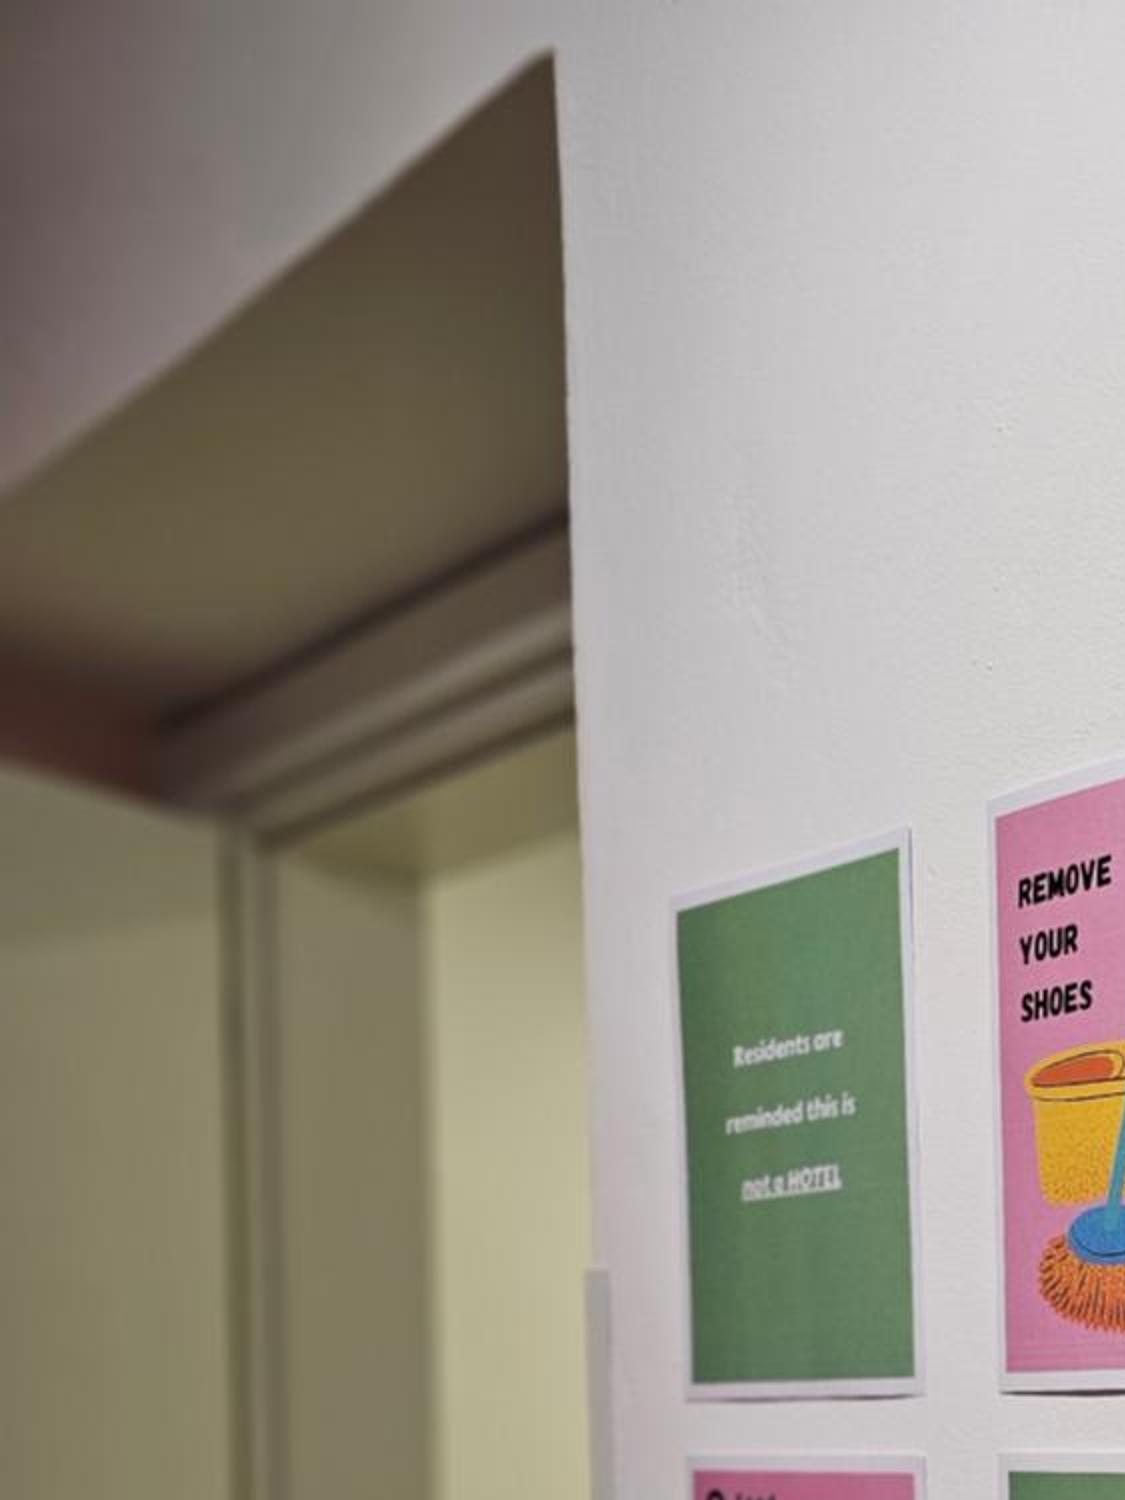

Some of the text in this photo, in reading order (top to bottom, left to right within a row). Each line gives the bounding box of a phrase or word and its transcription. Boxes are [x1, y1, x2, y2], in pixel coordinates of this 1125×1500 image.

[1018, 855, 1112, 908] REMOVE
[1019, 924, 1078, 965] YOUR
[1021, 980, 1093, 1023] SHOES
[733, 1028, 843, 1069] Residents are
[726, 1091, 856, 1135] reminded this is
[742, 1173, 771, 1200] not
[786, 1164, 842, 1193] HOTEL
